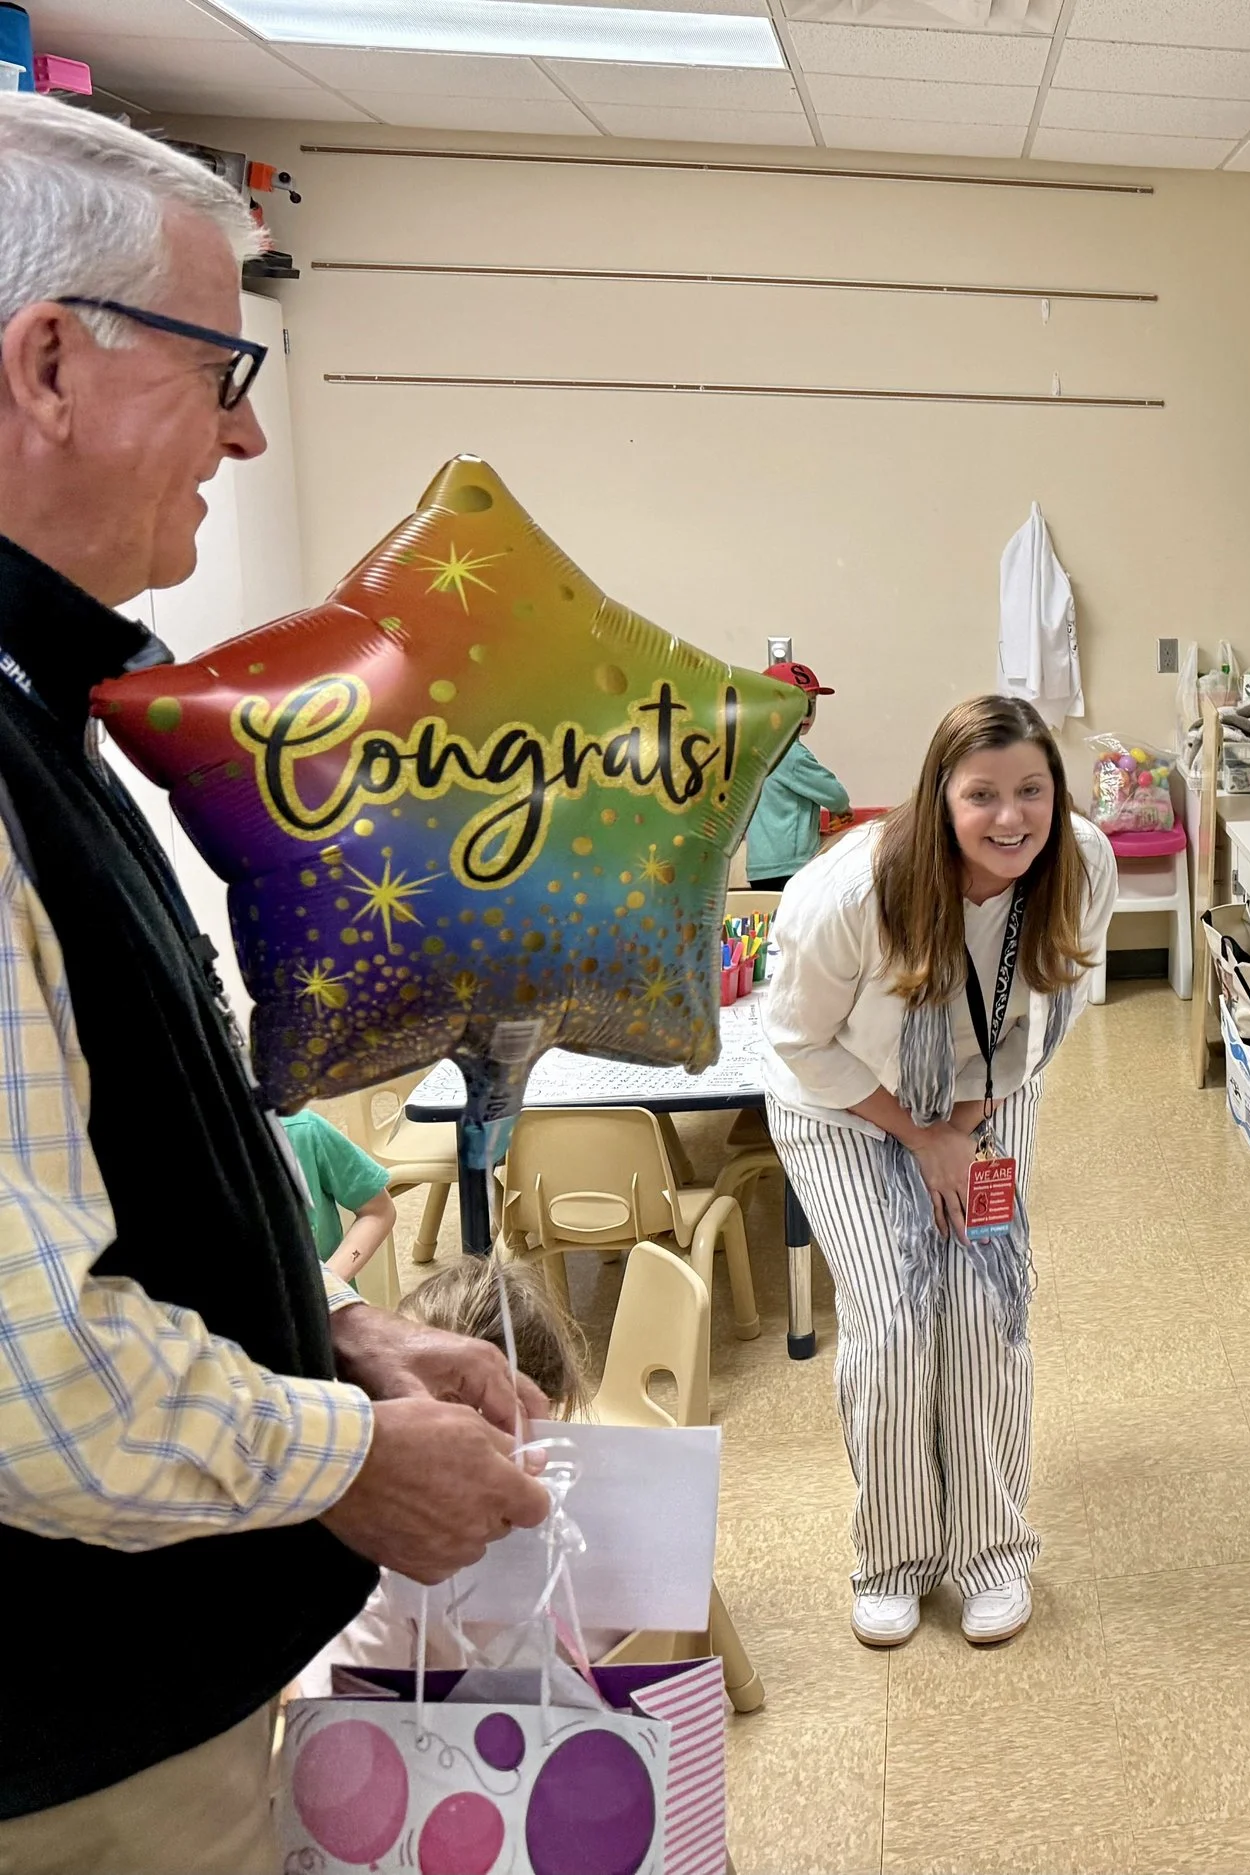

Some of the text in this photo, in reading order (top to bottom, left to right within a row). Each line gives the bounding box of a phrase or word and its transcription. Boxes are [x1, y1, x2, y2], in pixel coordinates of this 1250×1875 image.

[0, 653, 32, 694] THE
[790, 664, 811, 685] S
[234, 675, 741, 889] Congrats!
[974, 1167, 1012, 1182] WE ARE
